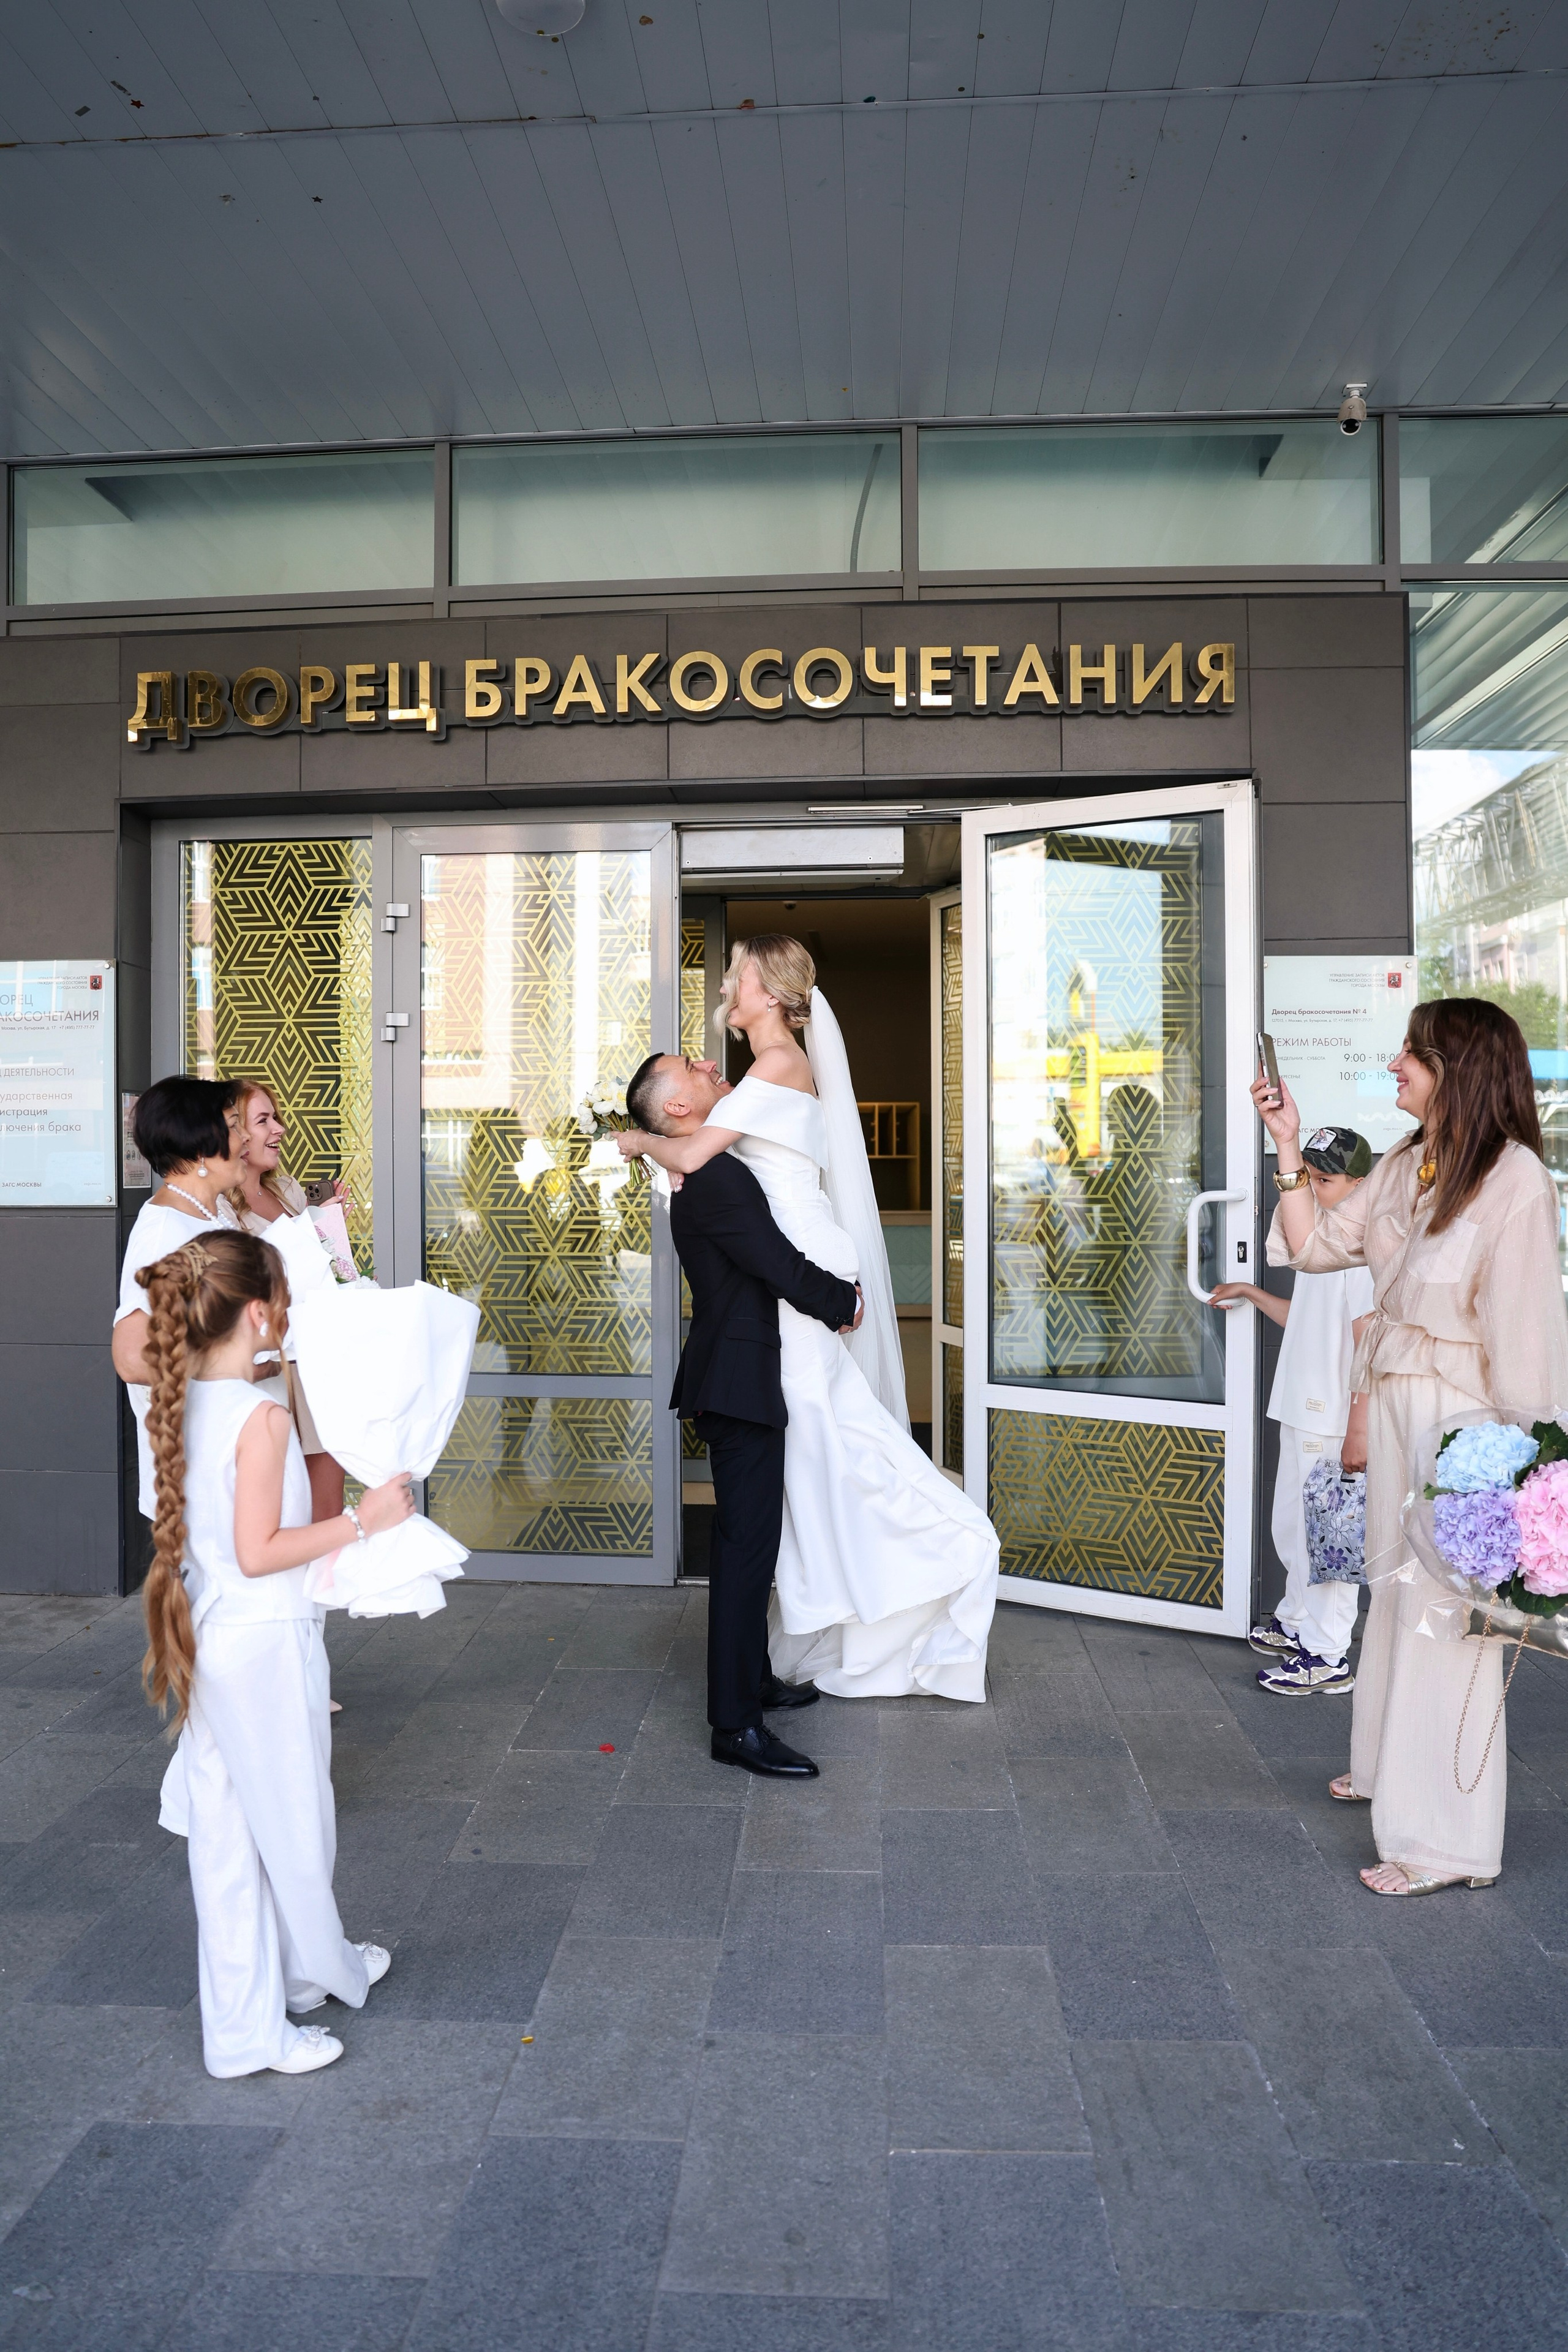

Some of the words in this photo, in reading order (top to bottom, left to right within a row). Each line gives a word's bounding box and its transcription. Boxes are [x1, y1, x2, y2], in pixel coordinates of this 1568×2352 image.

[127, 661, 437, 743] ДВОРЕЦ
[466, 642, 1235, 721] БРАКОСОЧЕТАНИЯ
[1313, 1038, 1351, 1046] РАБОТЫ
[1344, 1053, 1366, 1062] 9:00
[4, 1068, 74, 1077] ДЕЯТЕЛЬНОСТИ
[1340, 1071, 1366, 1080] 10:00
[1377, 1071, 1398, 1080] 19:0
[48, 1121, 81, 1134] брака
